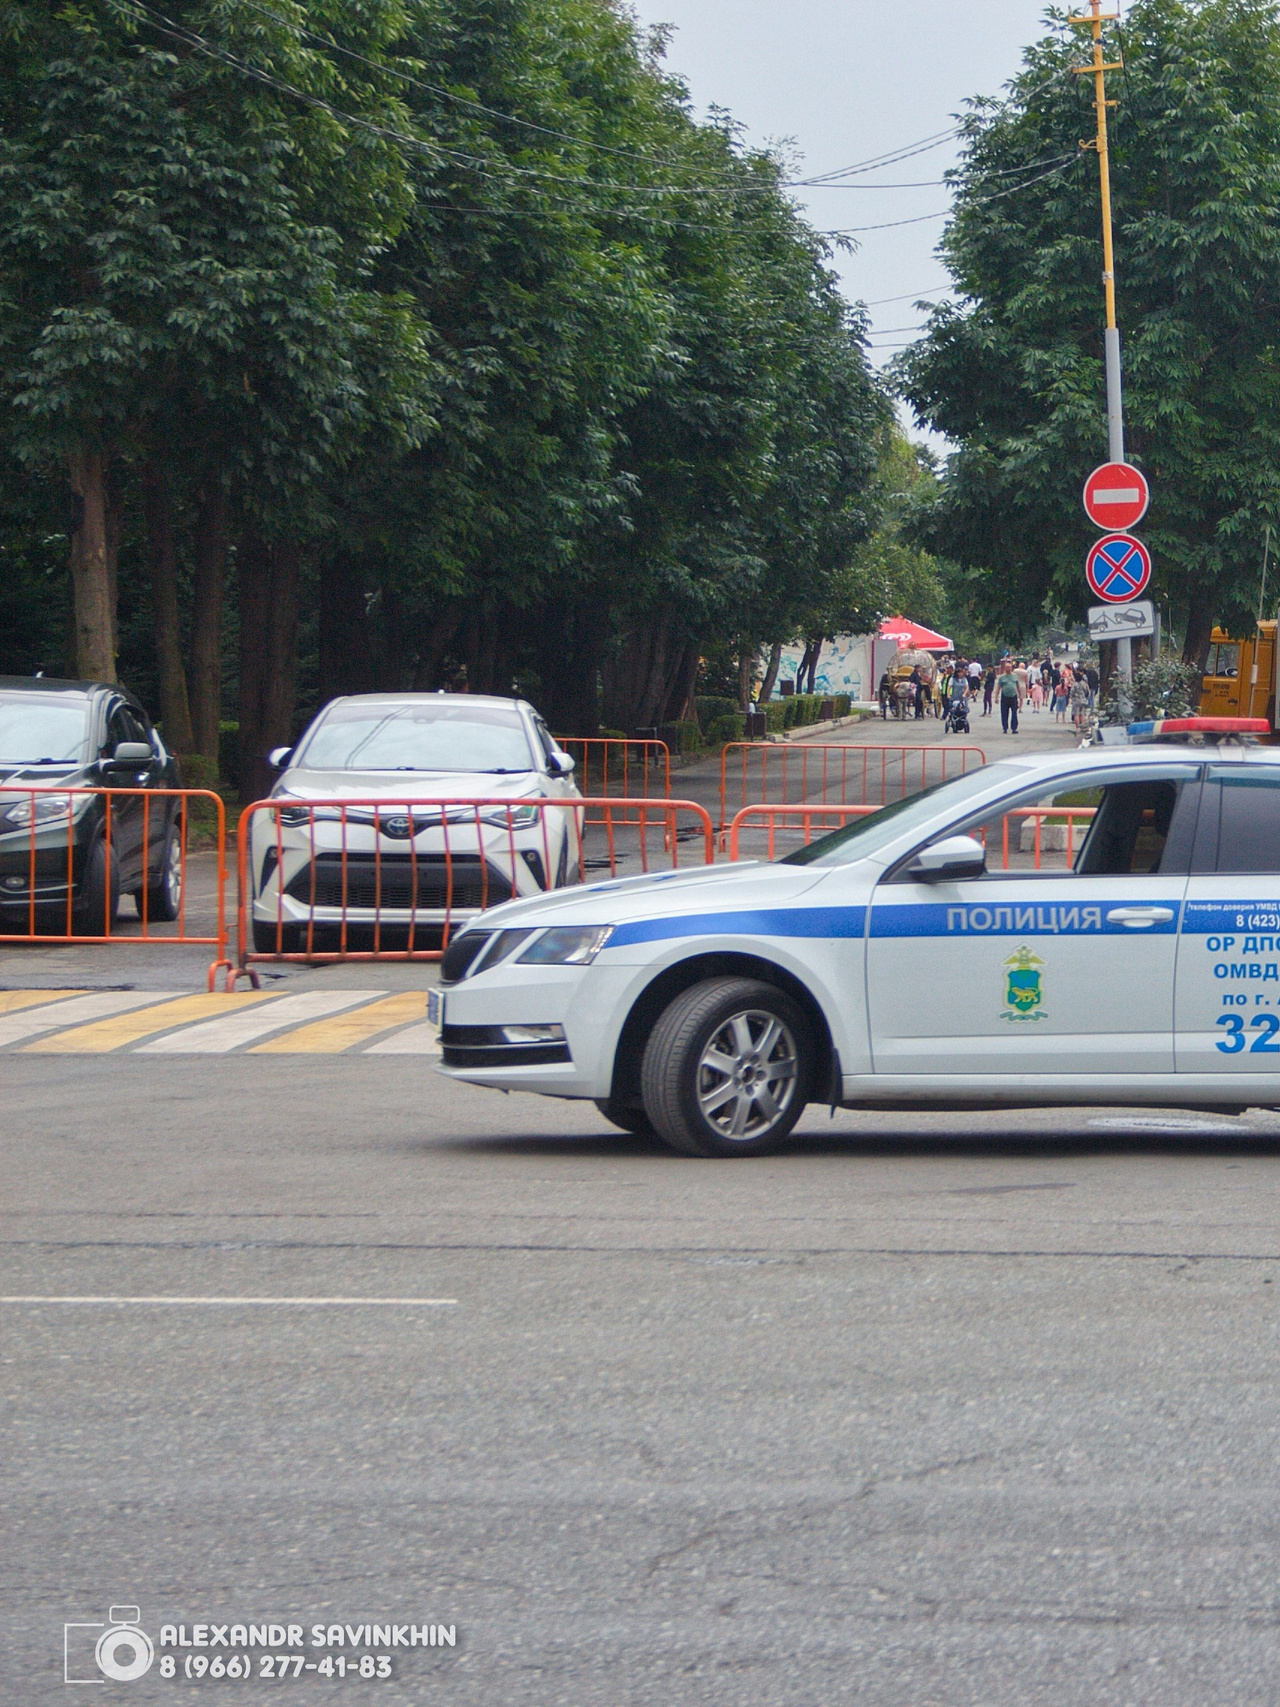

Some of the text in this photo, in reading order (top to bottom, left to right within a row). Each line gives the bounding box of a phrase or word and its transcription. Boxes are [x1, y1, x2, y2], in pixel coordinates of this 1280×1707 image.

[947, 907, 1102, 934] ПОЛИЦИЯ
[1236, 914, 1245, 928] 8
[1247, 914, 1280, 931] (423)
[1206, 936, 1235, 952] ОР
[1213, 963, 1279, 982] ОМВД
[1222, 994, 1248, 1006] по
[1255, 994, 1271, 1006] г.
